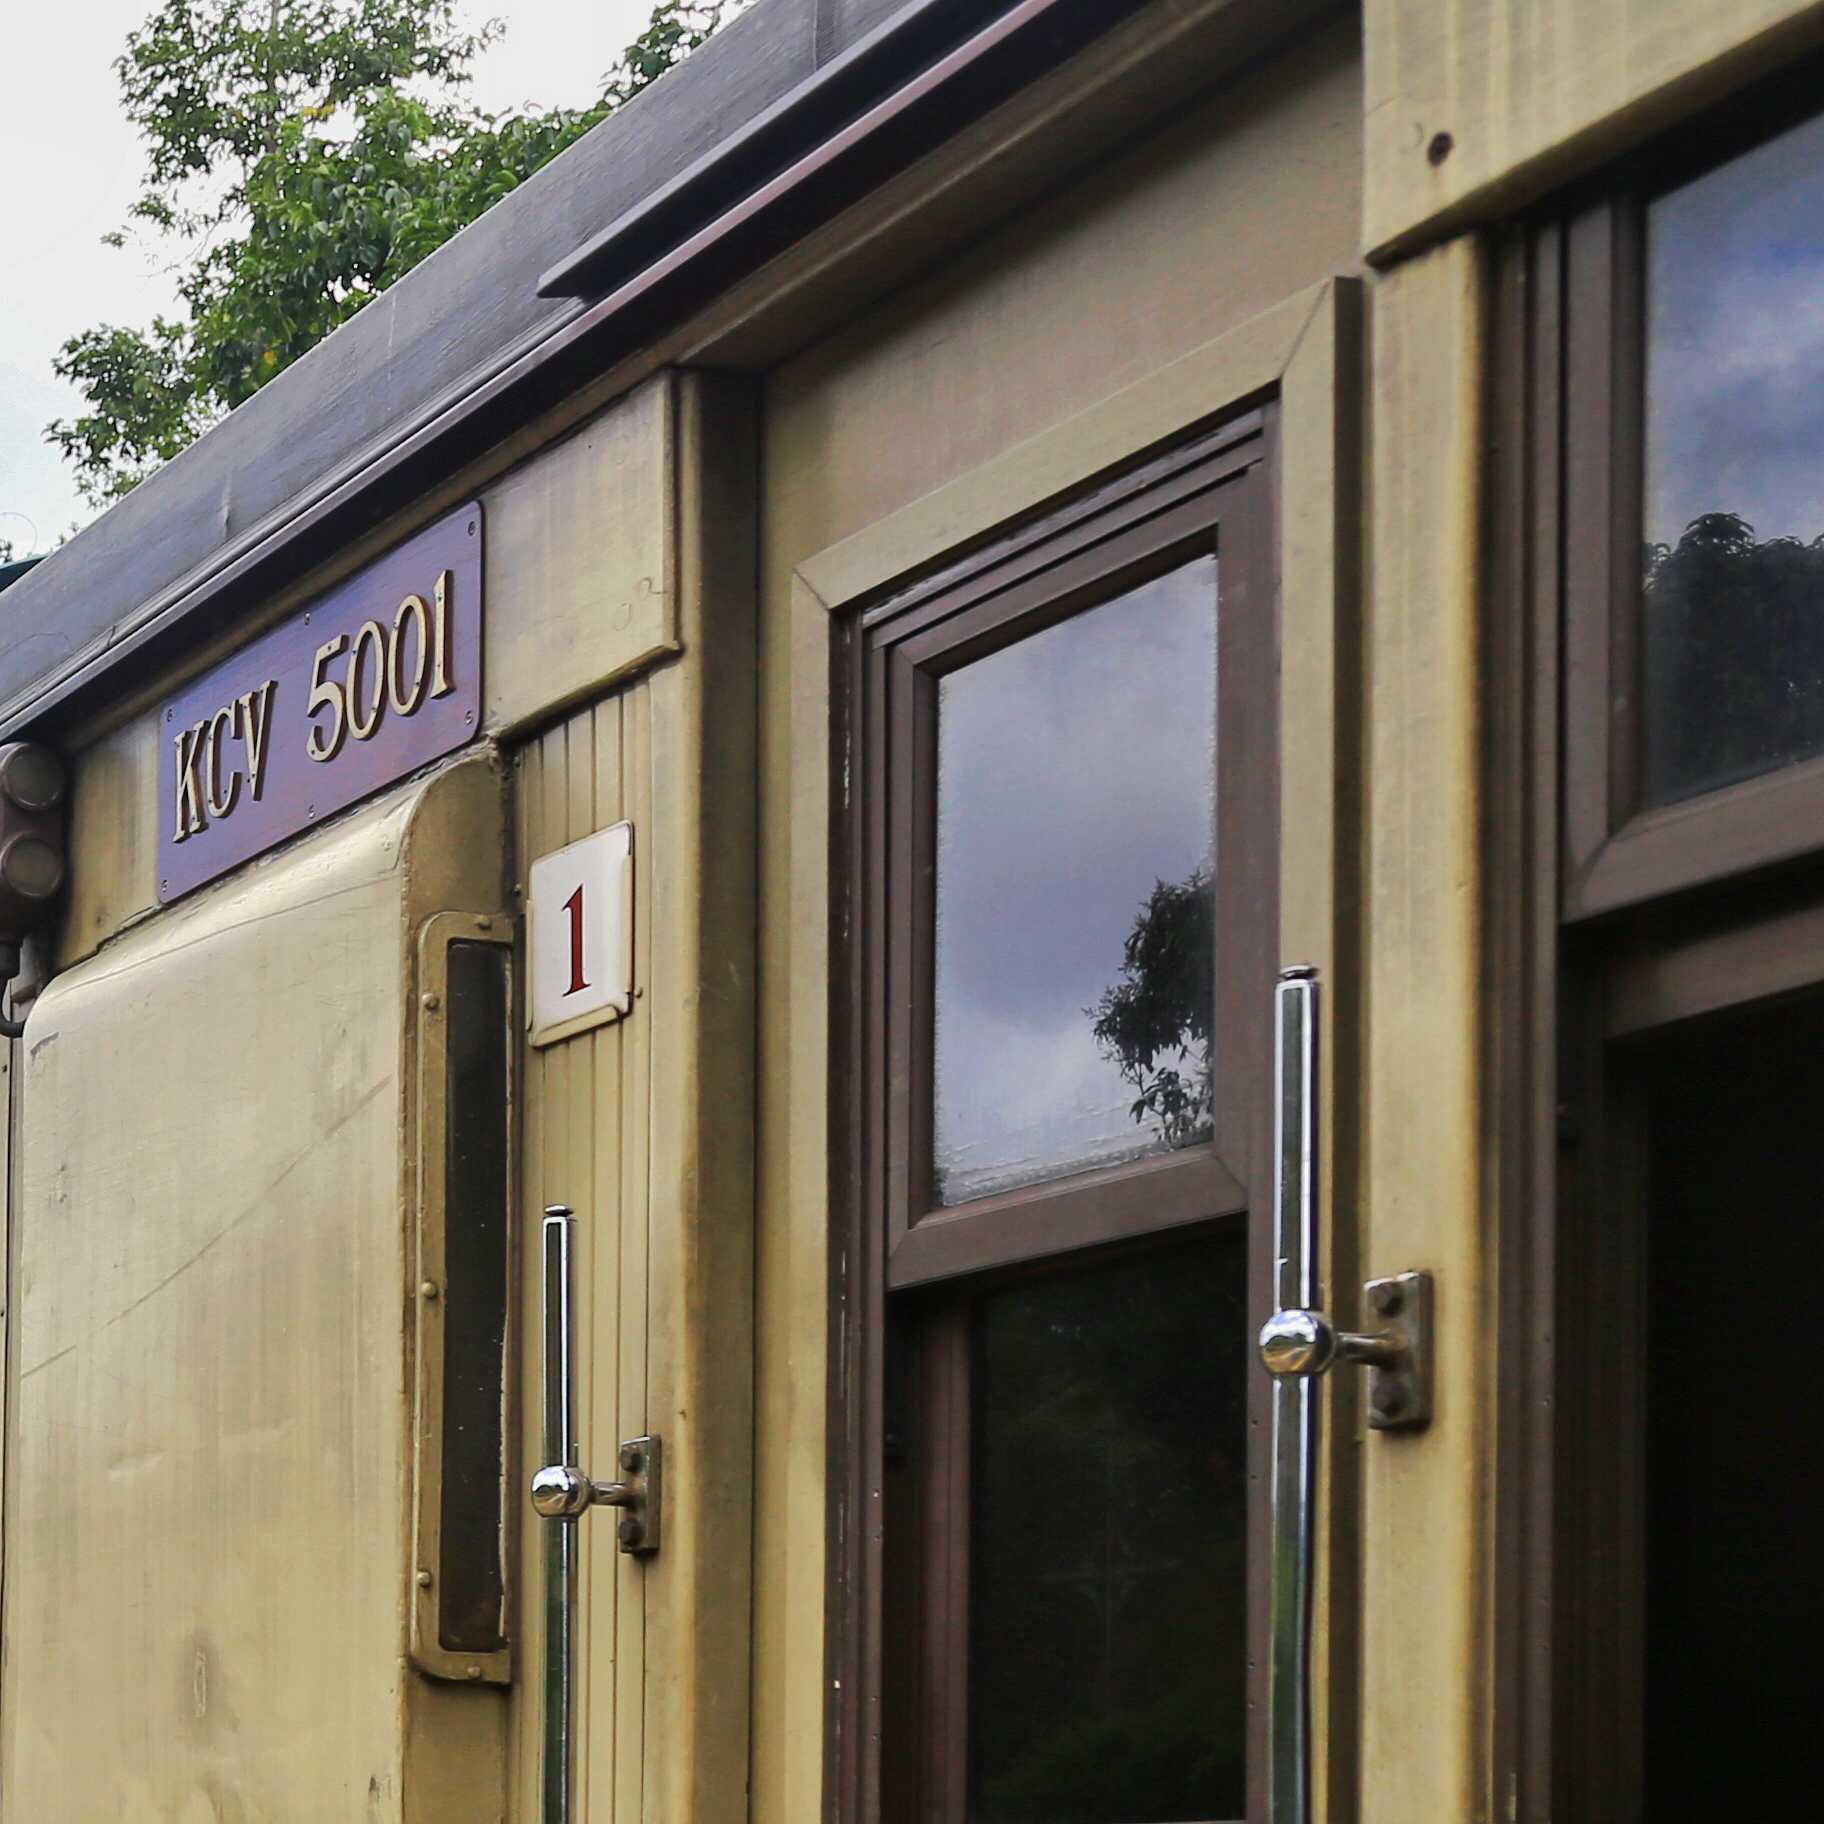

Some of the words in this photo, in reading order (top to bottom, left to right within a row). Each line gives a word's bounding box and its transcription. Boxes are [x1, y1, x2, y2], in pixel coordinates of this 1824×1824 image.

[172, 680, 277, 843] KCV
[305, 569, 453, 762] 5001
[561, 882, 591, 998] 1
